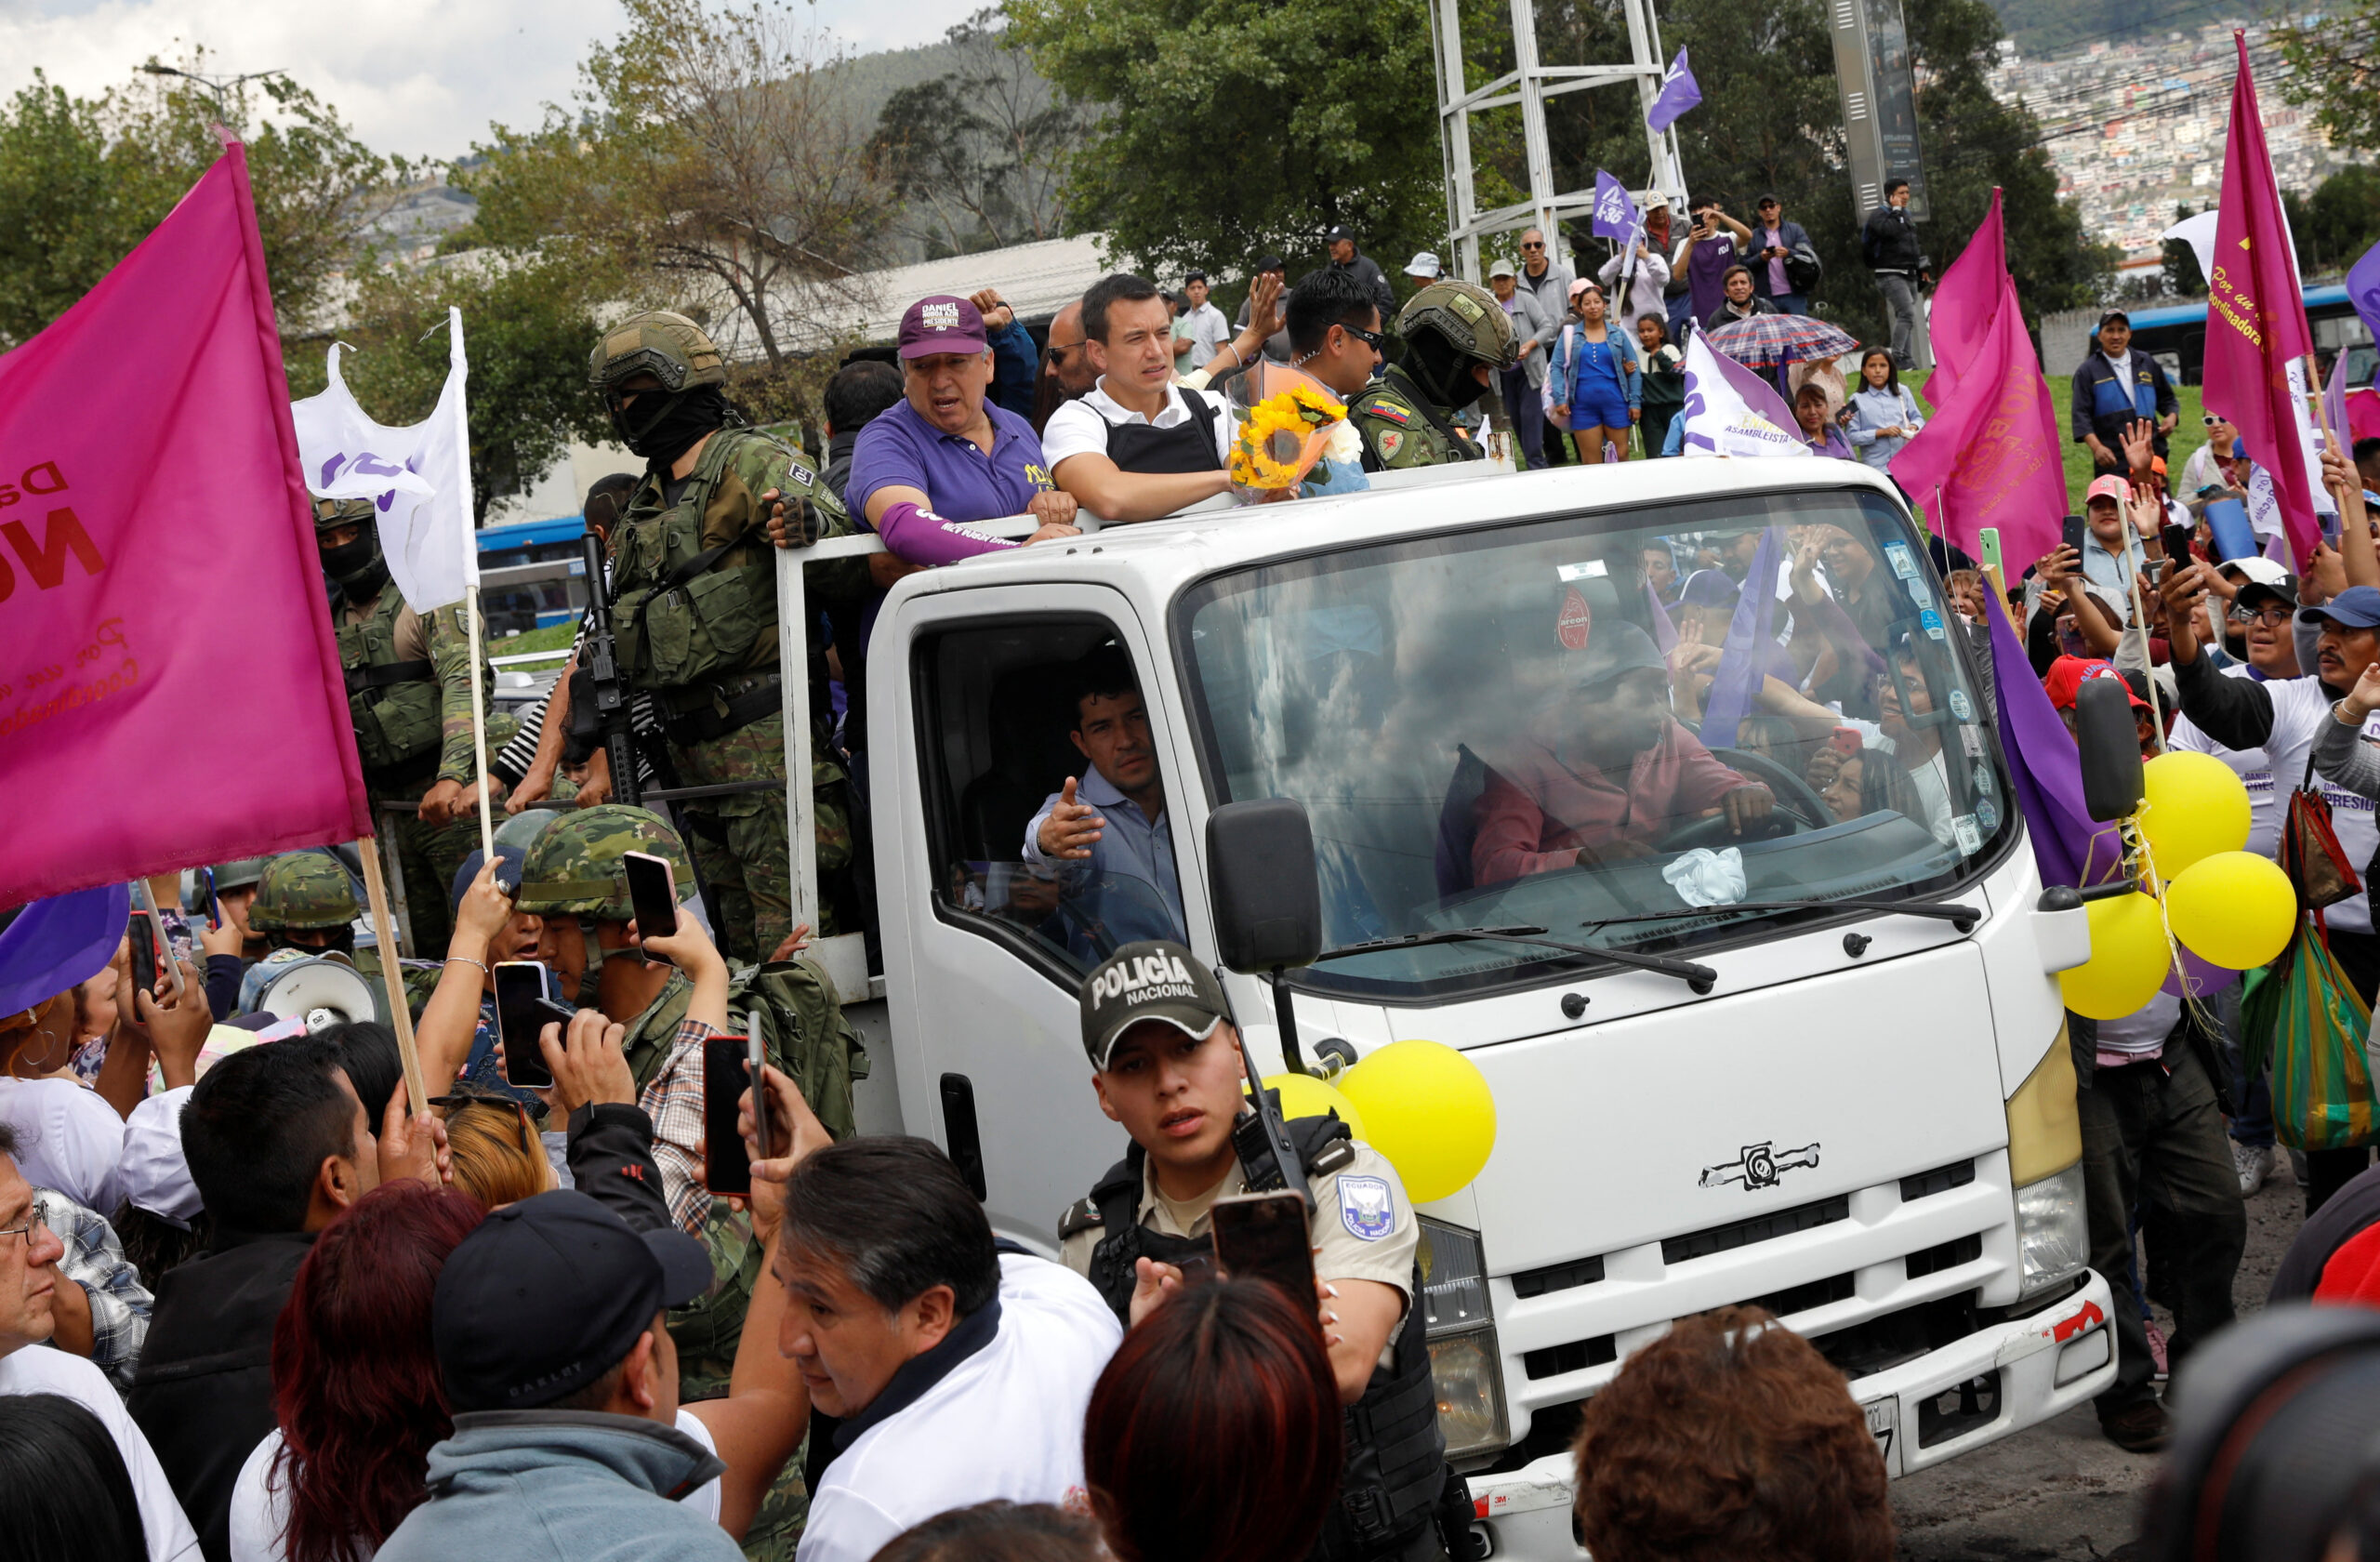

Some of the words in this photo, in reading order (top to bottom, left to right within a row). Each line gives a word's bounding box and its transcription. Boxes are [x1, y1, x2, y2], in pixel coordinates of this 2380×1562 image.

[2212, 266, 2233, 294] Por
[2234, 294, 2254, 311] un
[922, 302, 959, 313] DANIEL
[2208, 285, 2262, 346] oordinadora
[922, 318, 959, 327] PRESIDENTE
[1560, 616, 1588, 626] areon
[1091, 947, 1195, 1011] POLICÍA
[1126, 984, 1198, 1006] NACIONAL
[1345, 1182, 1384, 1191] ECUADOR
[1494, 1495, 1507, 1504] 3M
